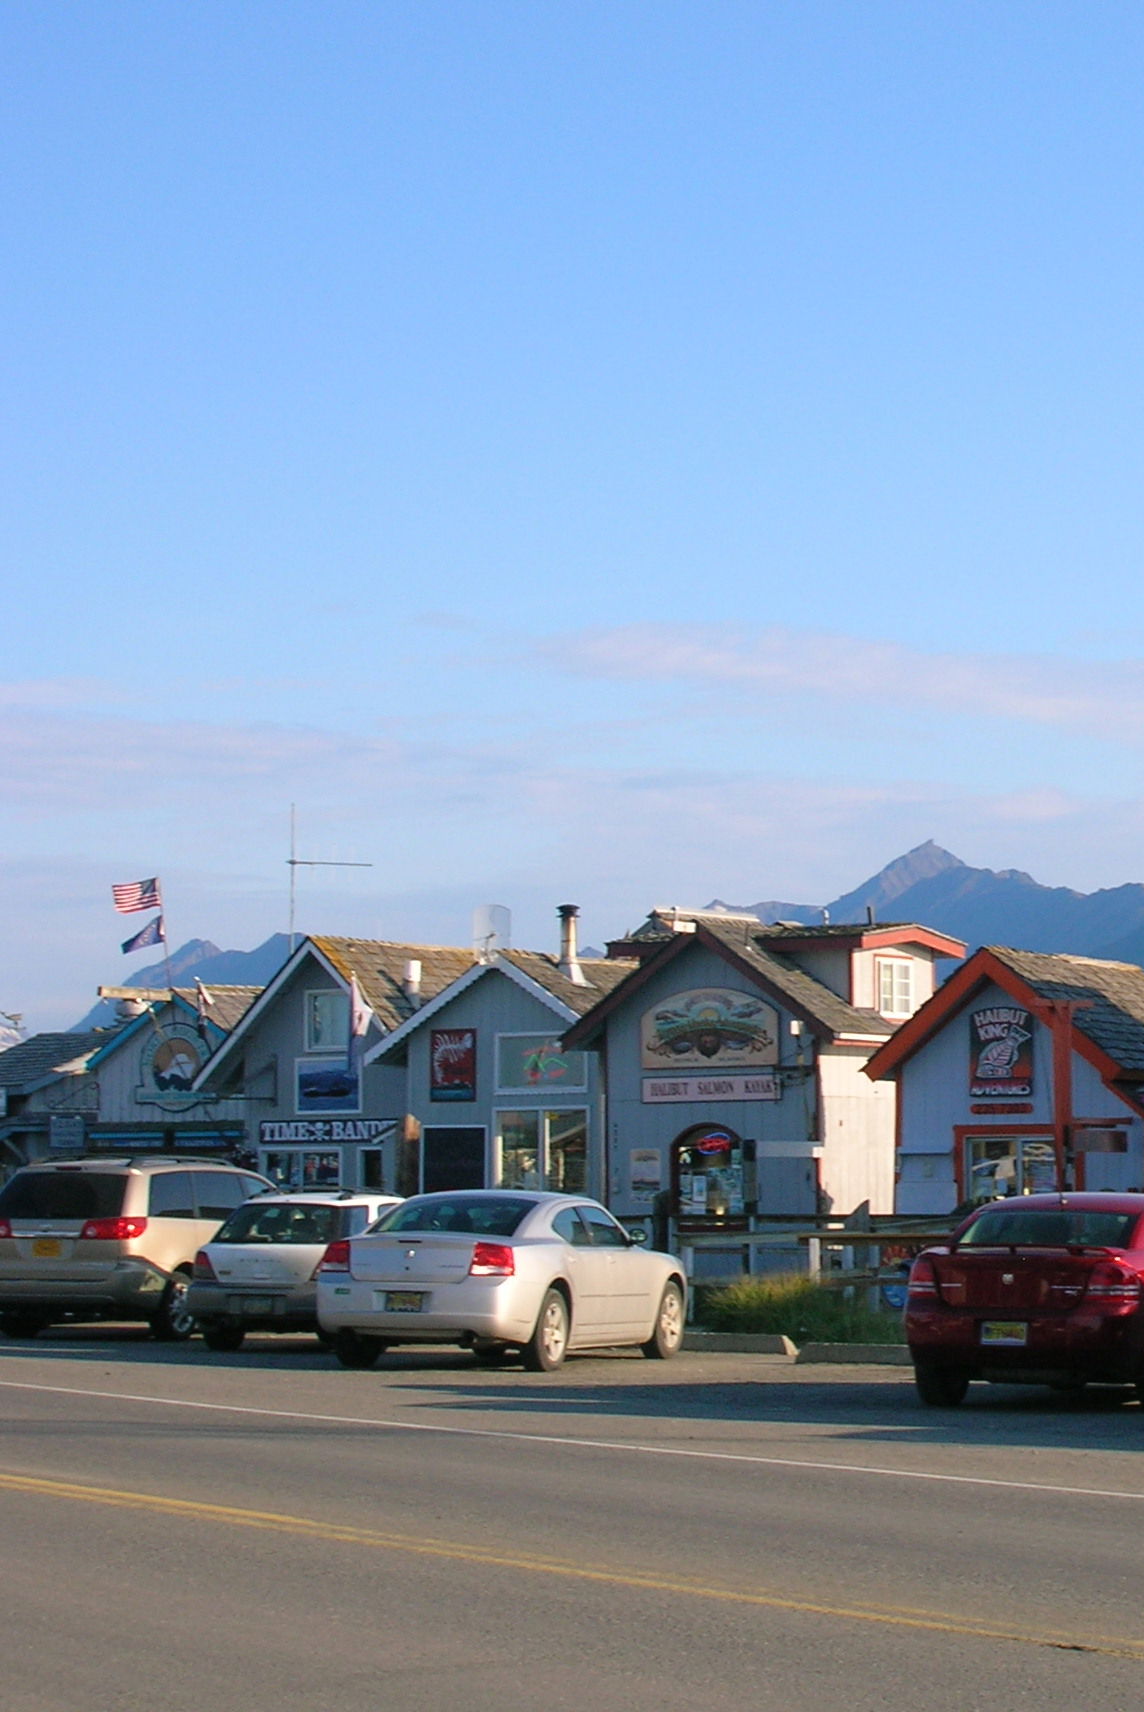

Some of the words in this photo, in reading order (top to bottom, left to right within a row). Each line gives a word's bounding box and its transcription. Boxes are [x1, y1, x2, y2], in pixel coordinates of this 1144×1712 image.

[973, 1008, 1029, 1027] HALIBUT
[977, 1023, 1009, 1040] KING
[650, 1082, 689, 1097] HALIBUT
[698, 1081, 734, 1095] SALMON
[262, 1121, 309, 1141] TIME
